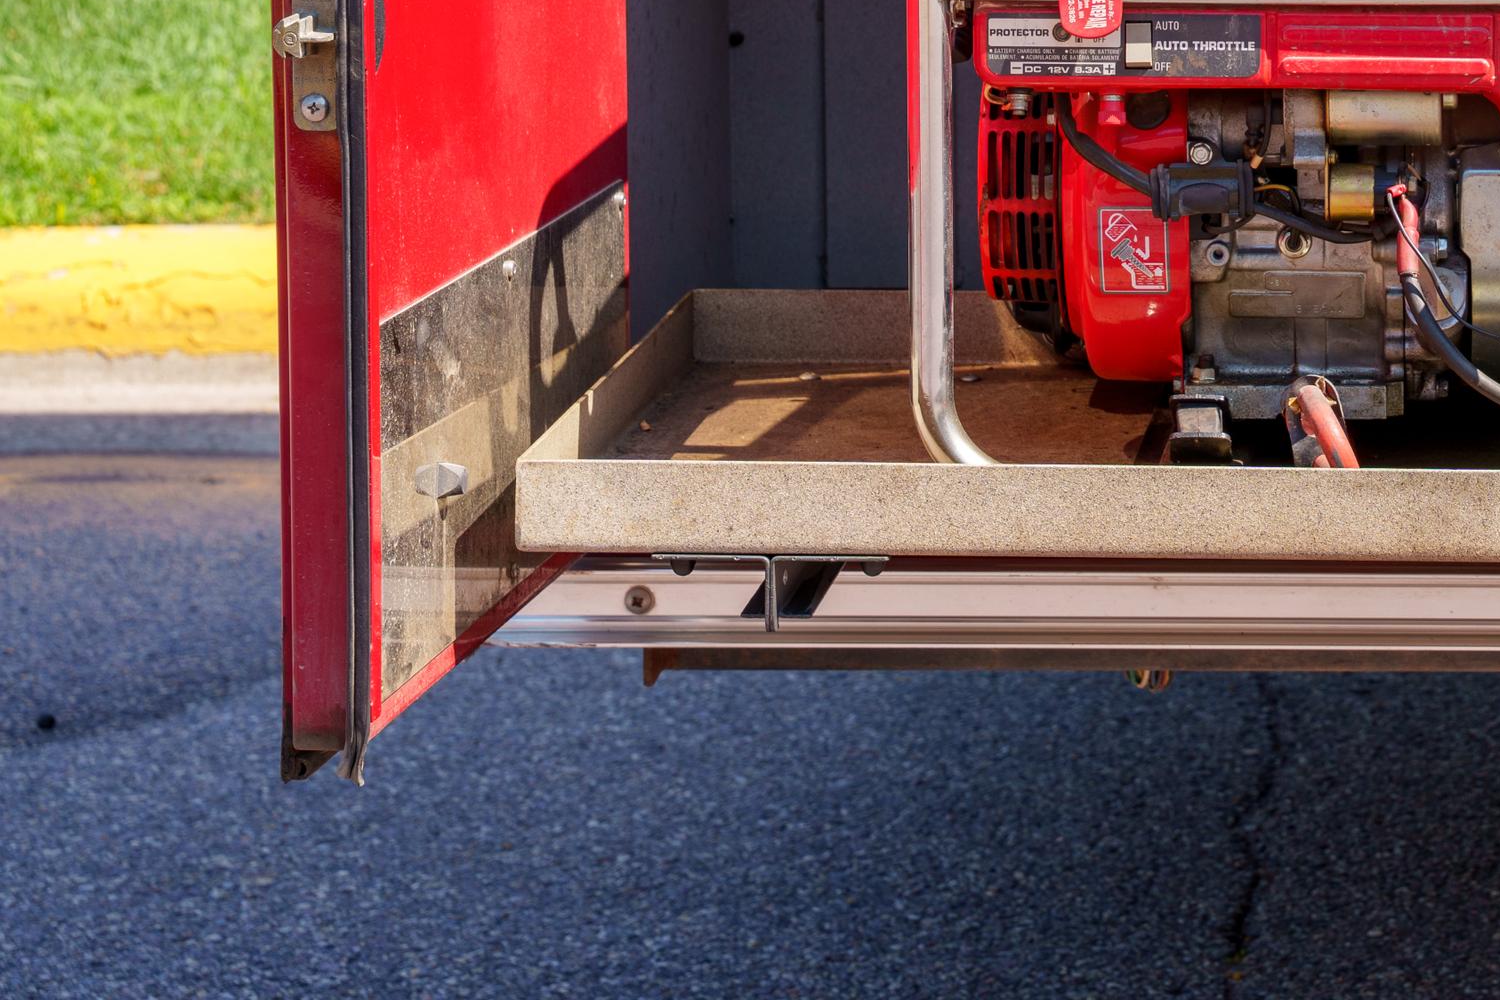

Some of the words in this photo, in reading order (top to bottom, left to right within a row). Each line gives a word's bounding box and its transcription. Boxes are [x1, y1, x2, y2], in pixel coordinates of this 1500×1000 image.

[1084, 4, 1108, 29] REPAIR
[1154, 20, 1180, 31] AUTO
[989, 28, 1049, 37] PROTECTOR
[1154, 40, 1189, 51] AUTO
[1192, 41, 1256, 51] THROTTLE
[1024, 65, 1042, 73] DC
[1047, 66, 1070, 74] 12V
[1074, 66, 1102, 74] 8.3A
[1154, 61, 1172, 72] OFF
